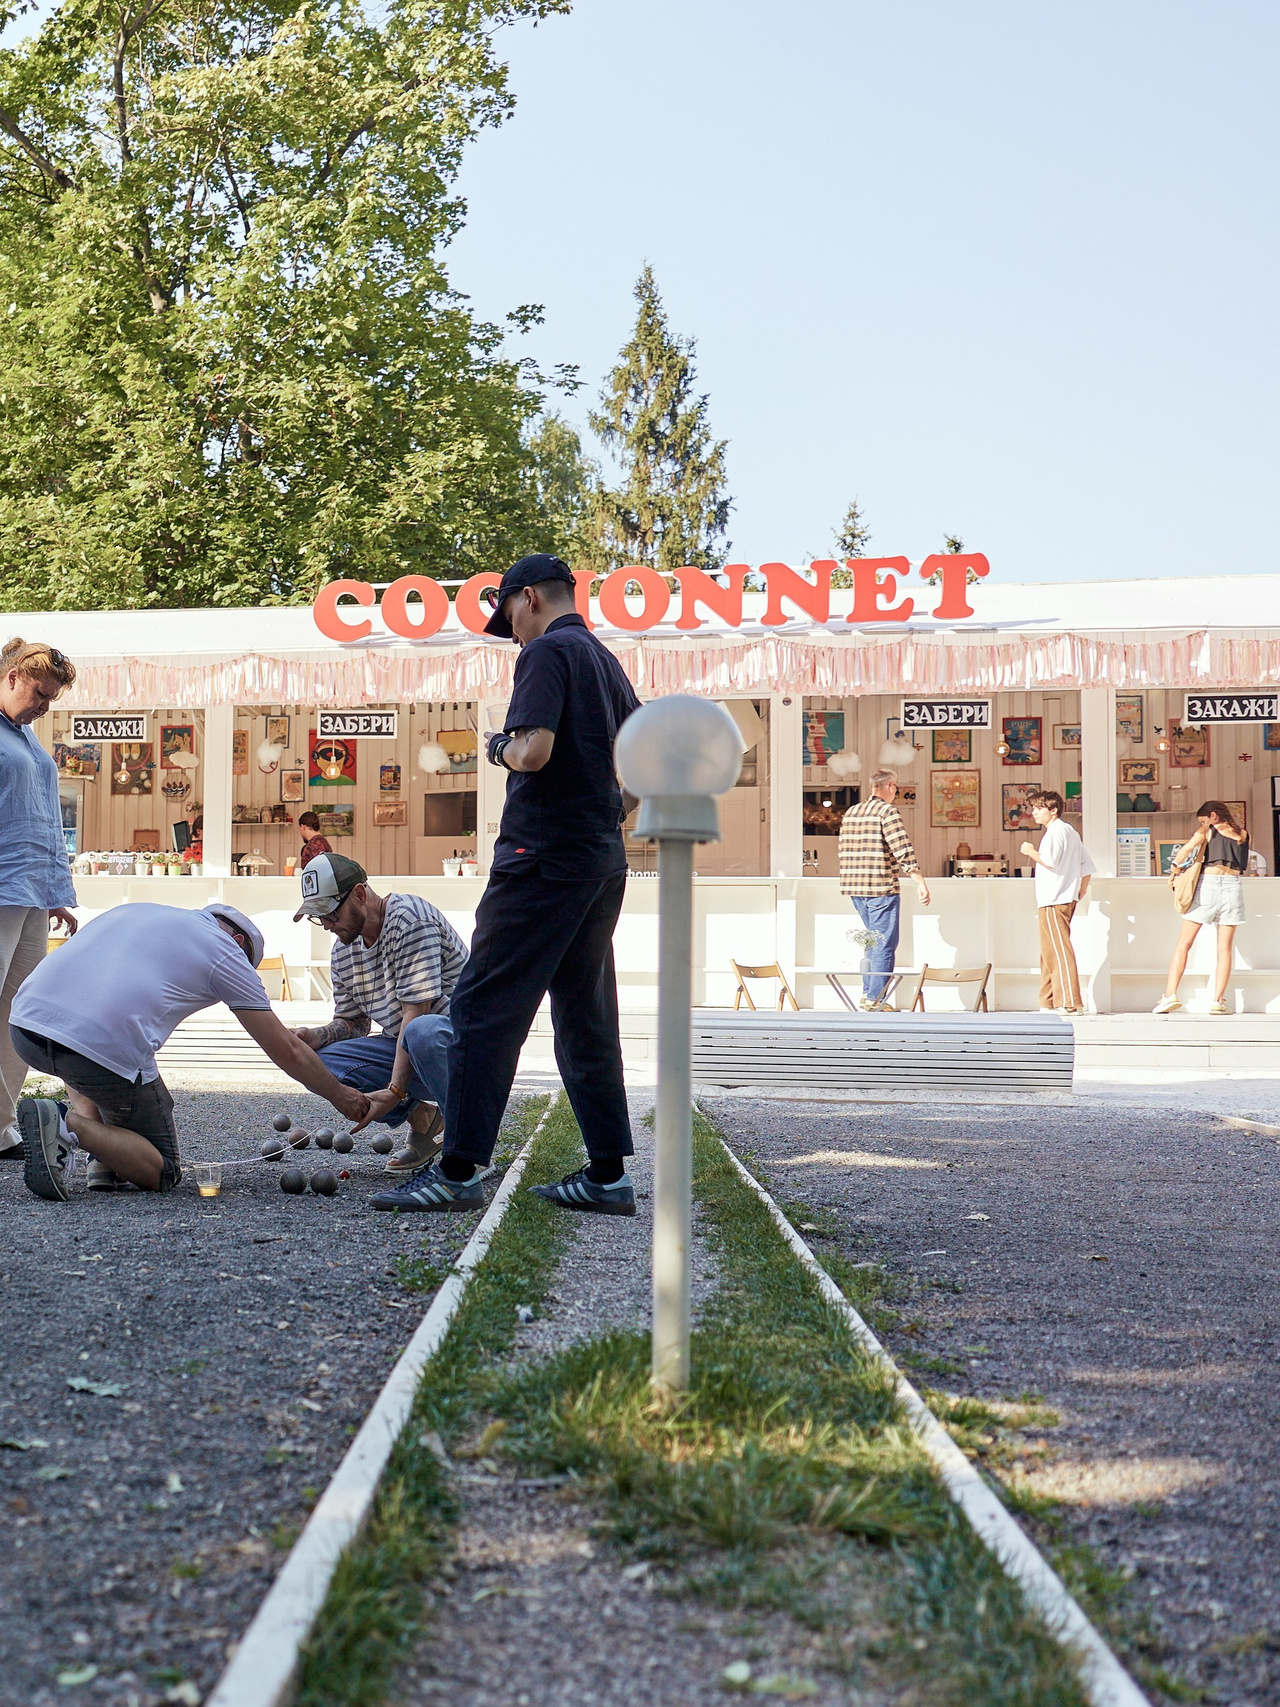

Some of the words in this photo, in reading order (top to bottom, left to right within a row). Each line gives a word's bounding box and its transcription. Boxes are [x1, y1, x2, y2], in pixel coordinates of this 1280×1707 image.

[904, 703, 989, 724] ЗАБЕРИ
[1187, 698, 1279, 719] ЗАКАЖИ
[73, 720, 144, 738] ЗАКАЖИ
[320, 715, 395, 734] ЗАБЕРИ
